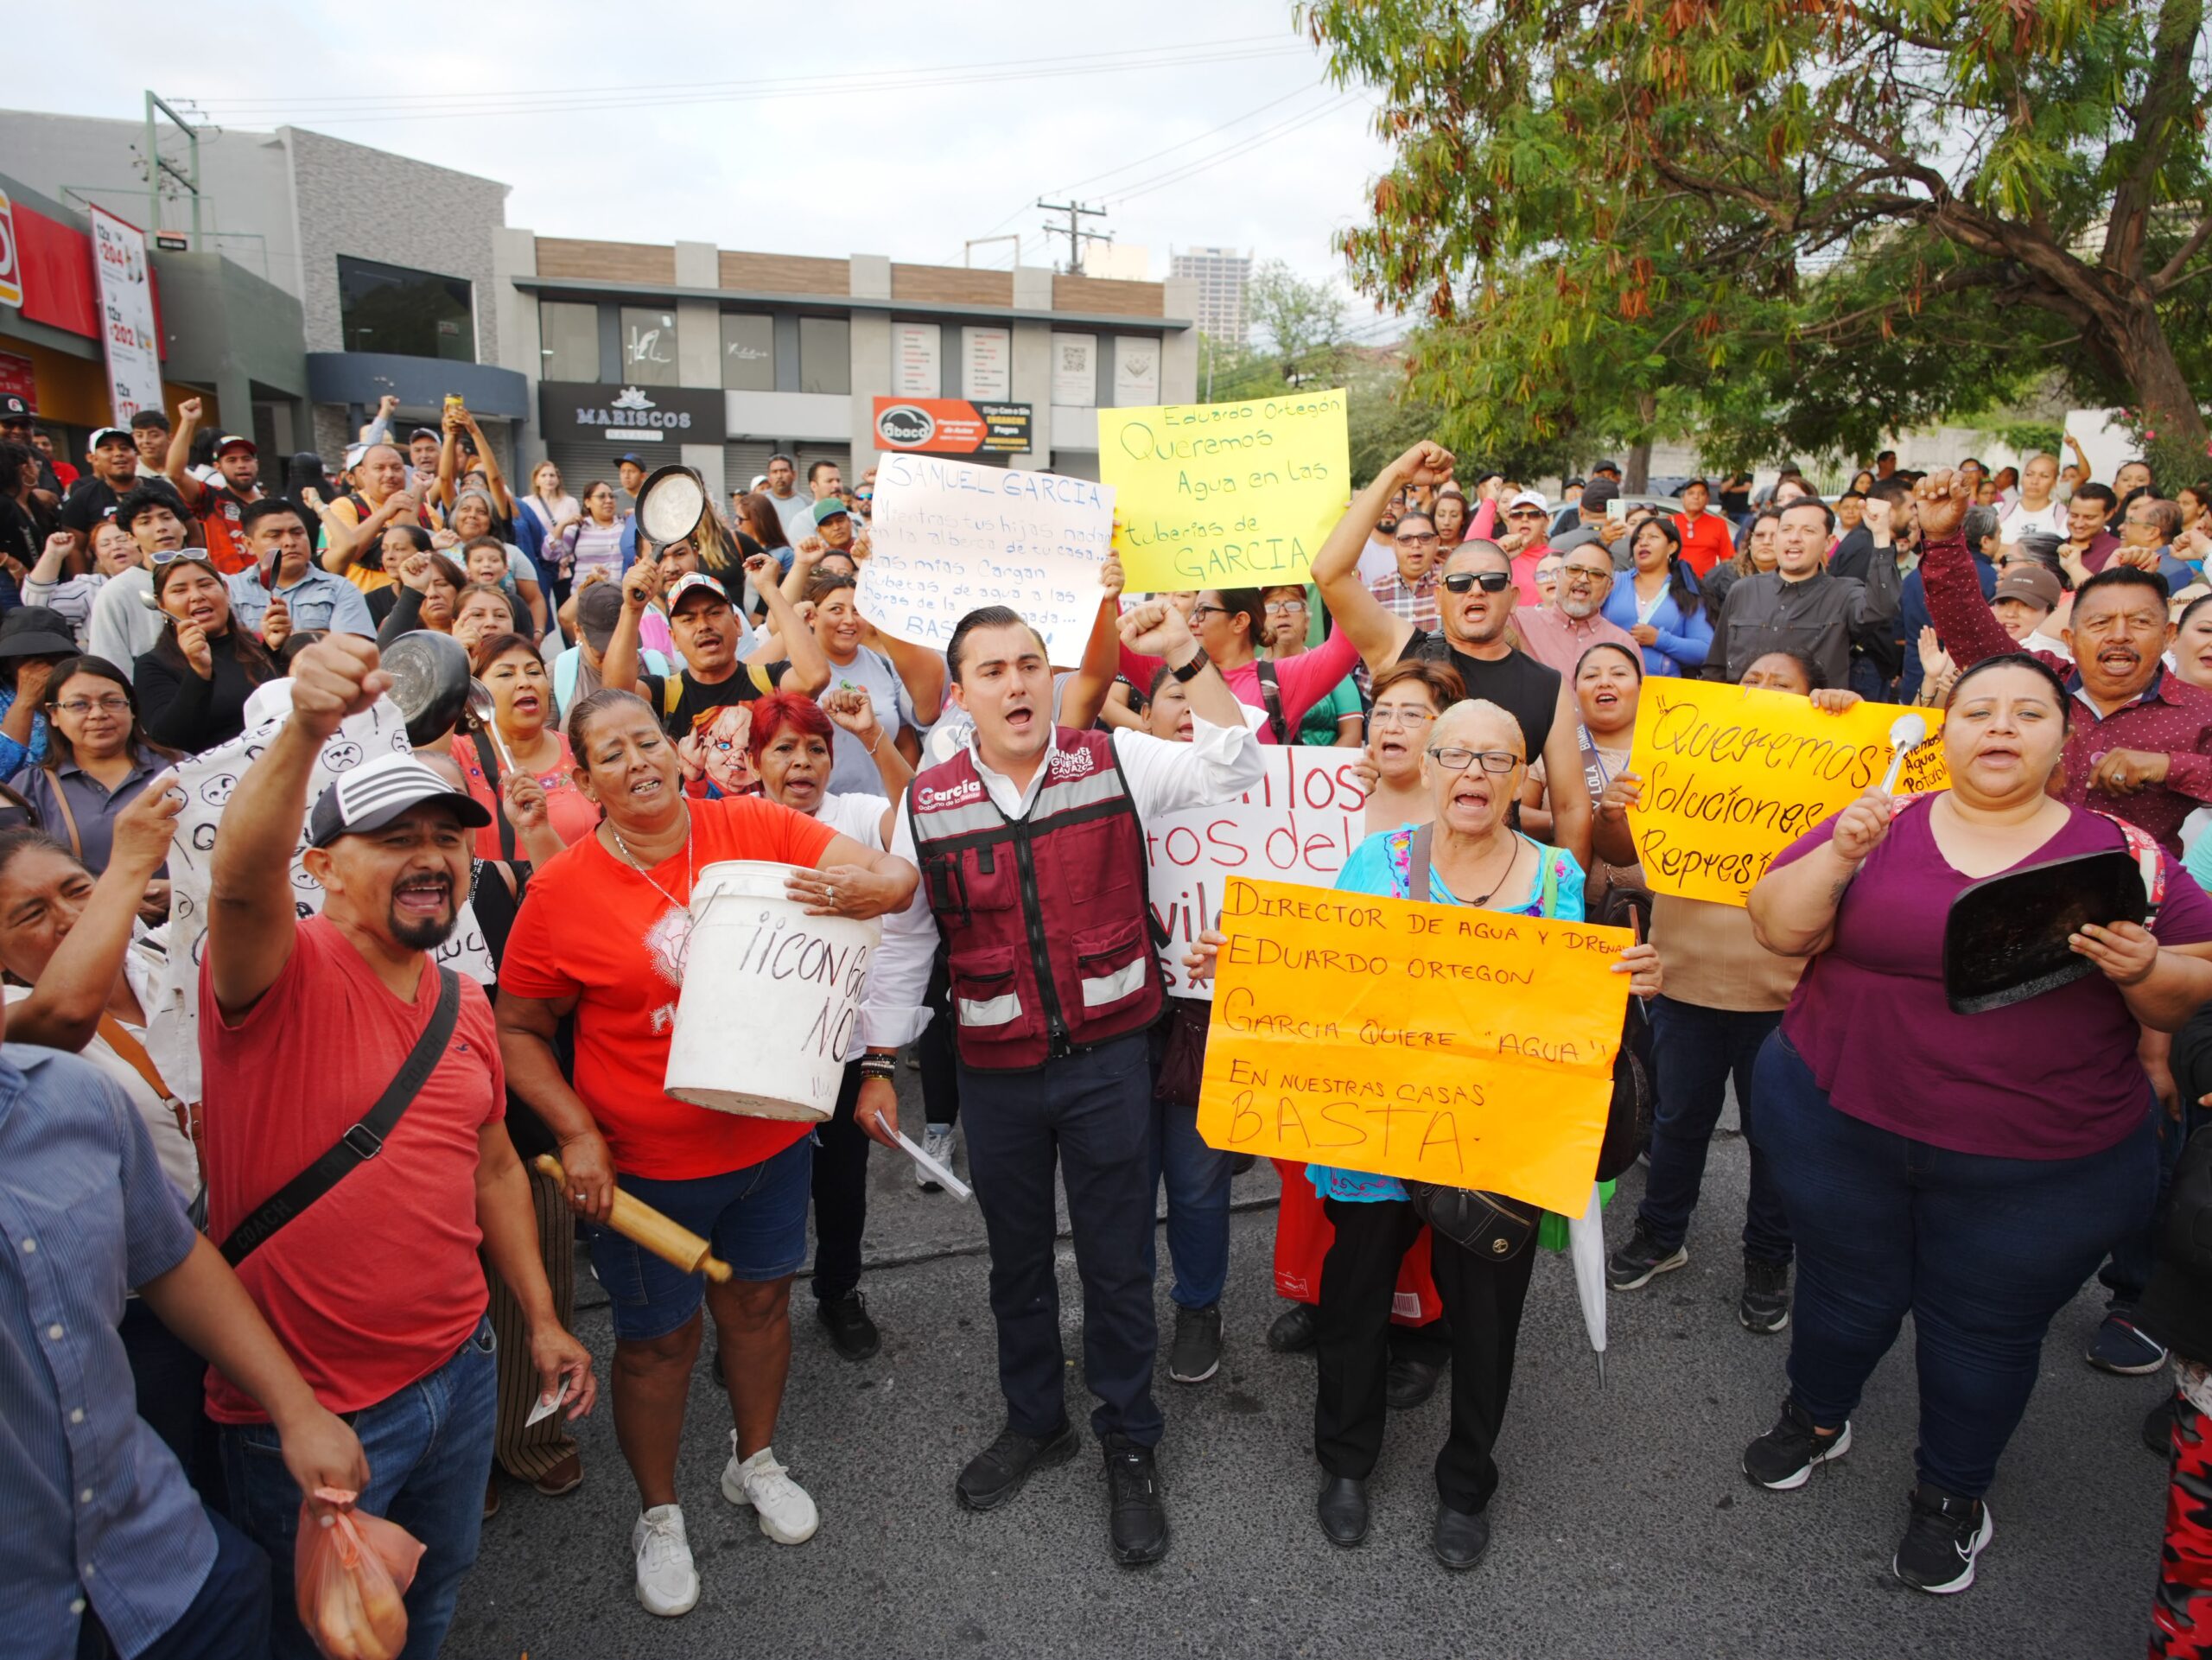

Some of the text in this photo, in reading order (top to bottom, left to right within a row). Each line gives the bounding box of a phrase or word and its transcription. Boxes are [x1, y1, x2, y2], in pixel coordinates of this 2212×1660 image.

[576, 408, 691, 429] MARISCOS
[1164, 406, 1253, 426] Eduardo
[1120, 422, 1273, 461] Queremos
[887, 457, 1102, 509] SAMUEL GARCIA
[1178, 469, 1236, 501] Agua
[1249, 469, 1279, 488] en
[1234, 515, 1260, 532] de
[1174, 536, 1311, 582] GARCIA
[979, 588, 1021, 603] agua
[905, 615, 959, 641] BAS
[1287, 746, 1367, 813] los
[1585, 764, 1603, 795] LOLA
[1903, 760, 1948, 794] Potabl
[1904, 752, 1937, 775] Agua
[918, 779, 982, 805] García
[1147, 819, 1249, 868] tos
[1640, 828, 1773, 889] Represi
[1220, 881, 1387, 931] DIRECTOR
[1407, 913, 1444, 936] DE
[1459, 922, 1520, 942] AGUA
[1537, 930, 1549, 946] Y
[1228, 933, 1389, 977] EDUARDO
[1407, 957, 1535, 986] ORTEGON
[801, 996, 854, 1063] NO
[1224, 987, 1340, 1040] GARCIA
[1358, 1018, 1459, 1048] QUIERE
[1229, 1058, 1486, 1107] EN NUESTRAS CASAS
[235, 1199, 293, 1250] COACH
